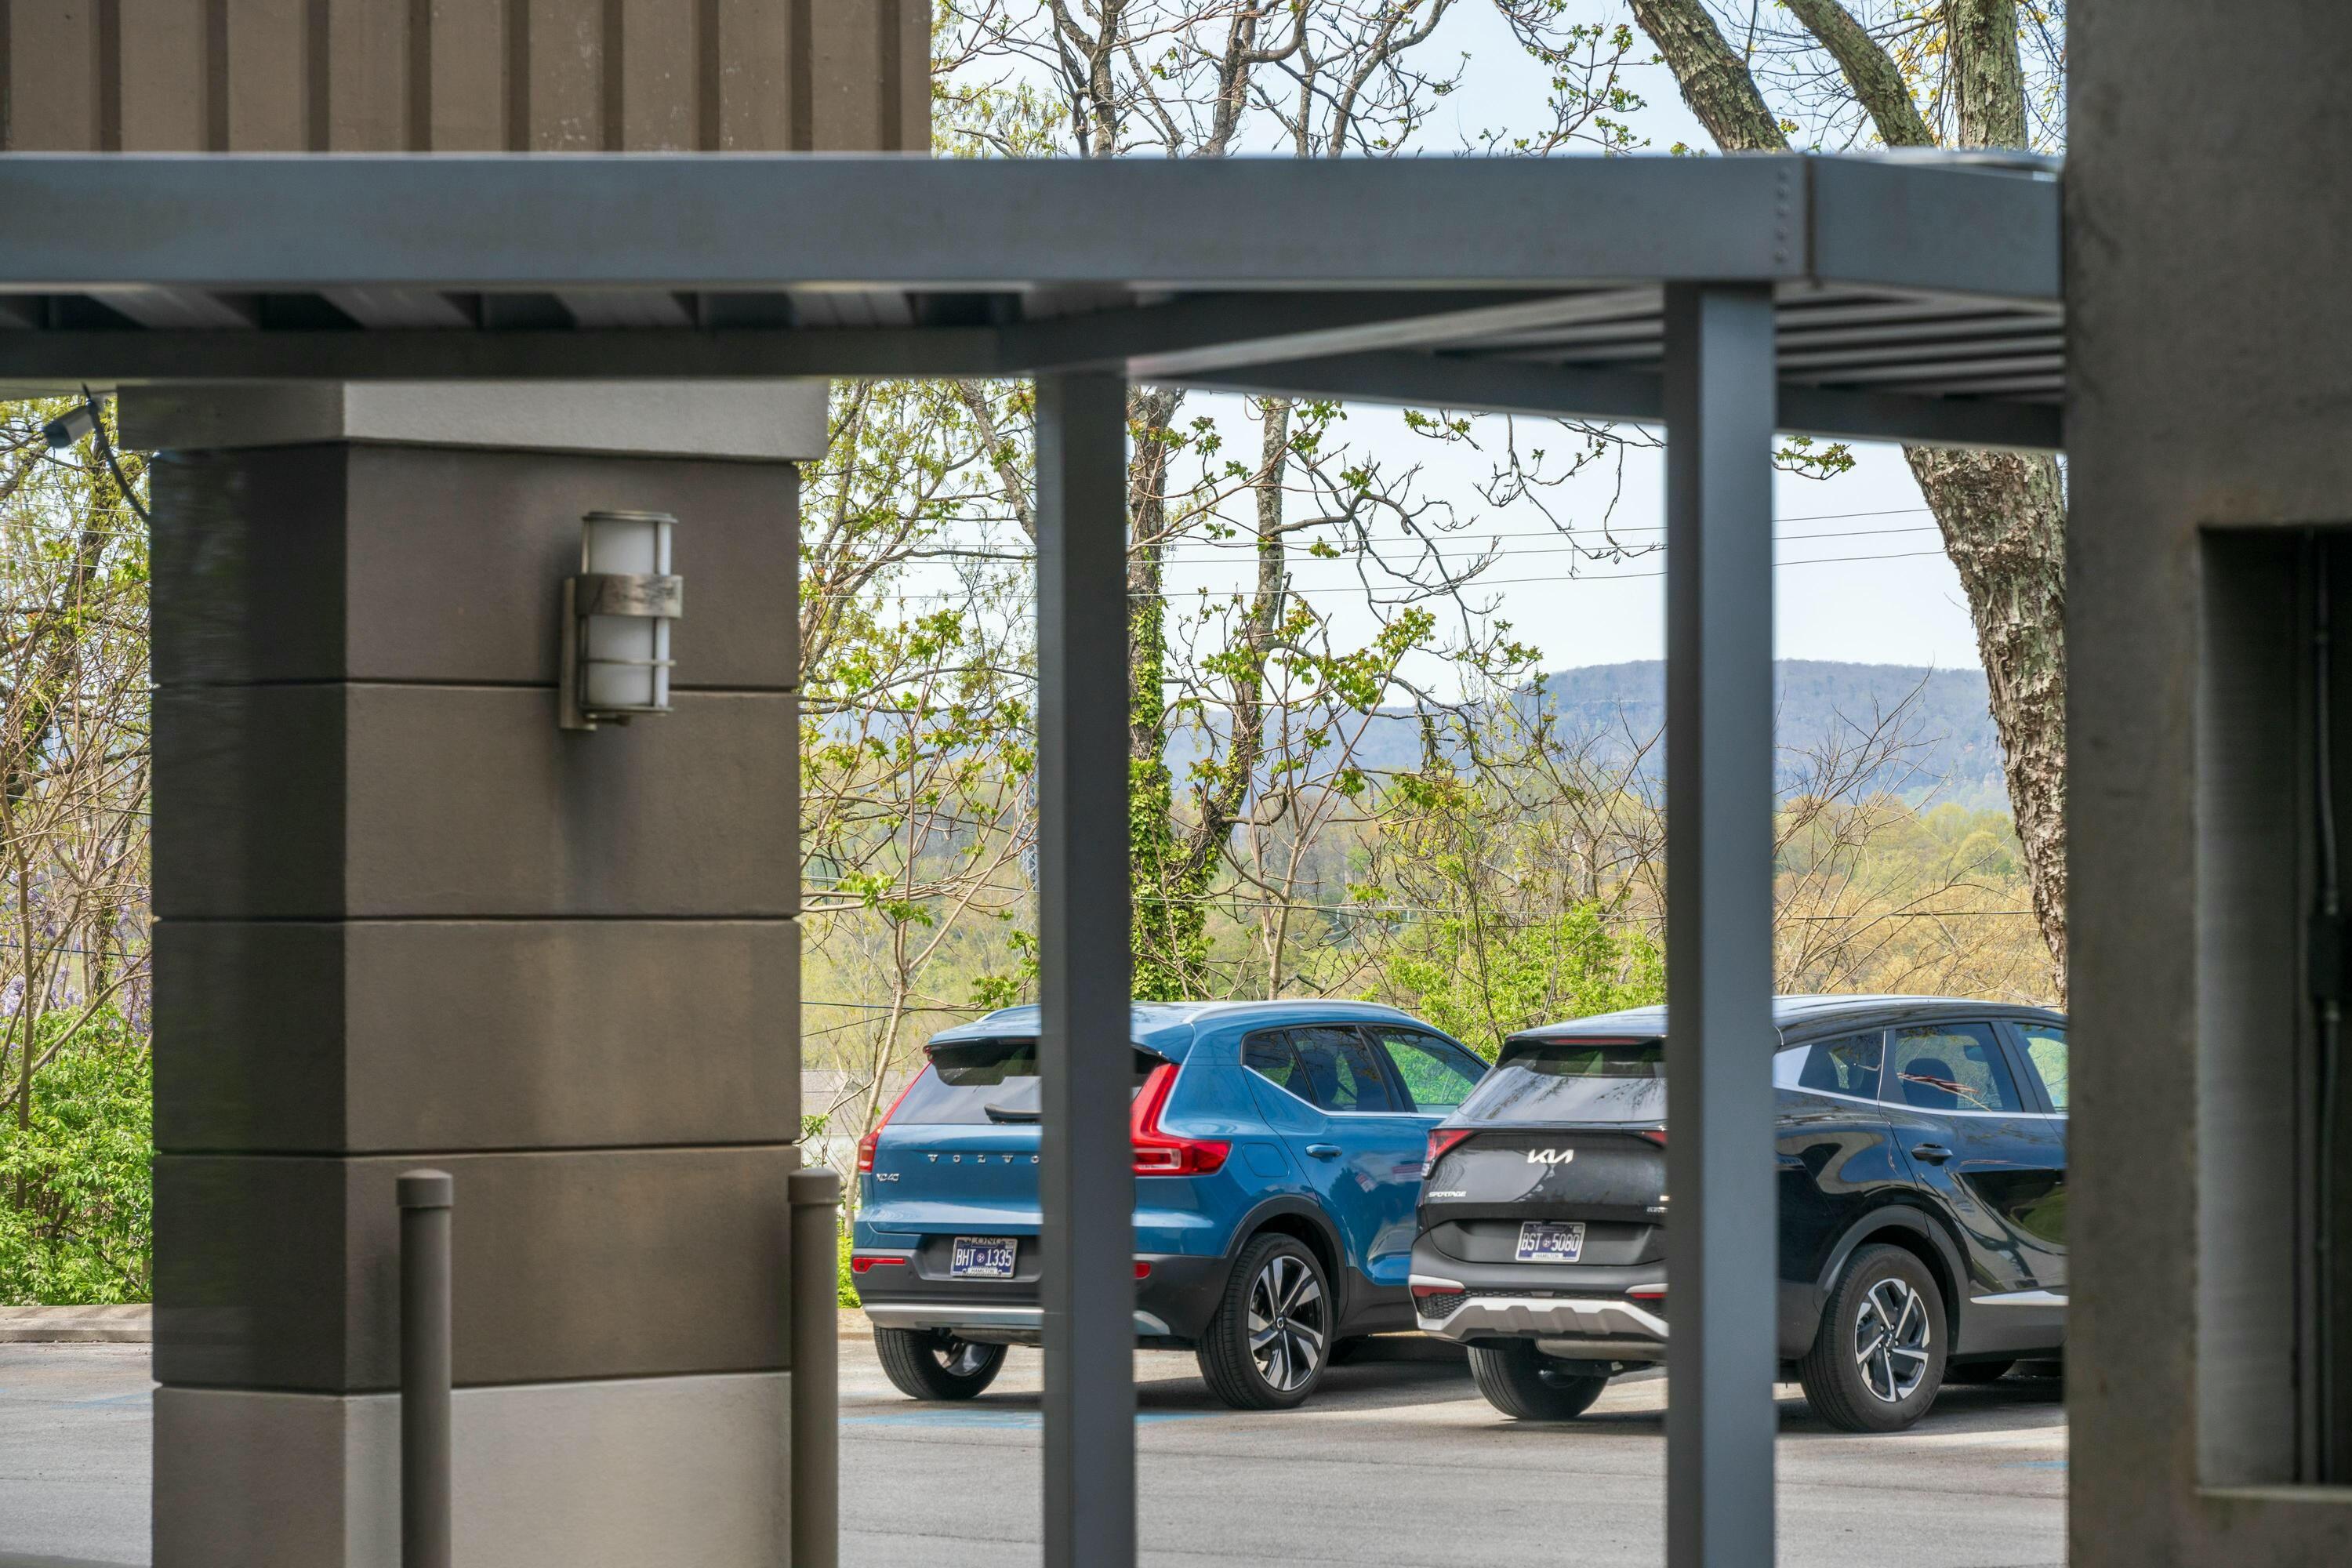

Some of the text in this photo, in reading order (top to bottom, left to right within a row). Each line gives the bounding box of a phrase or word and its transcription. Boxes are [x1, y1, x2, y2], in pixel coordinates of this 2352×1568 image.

[927, 1154, 1040, 1163] VOLVO
[1527, 1149, 1573, 1163] KIA
[1521, 1232, 1580, 1252] BST 5080
[956, 1248, 1012, 1267] BHT 1335
